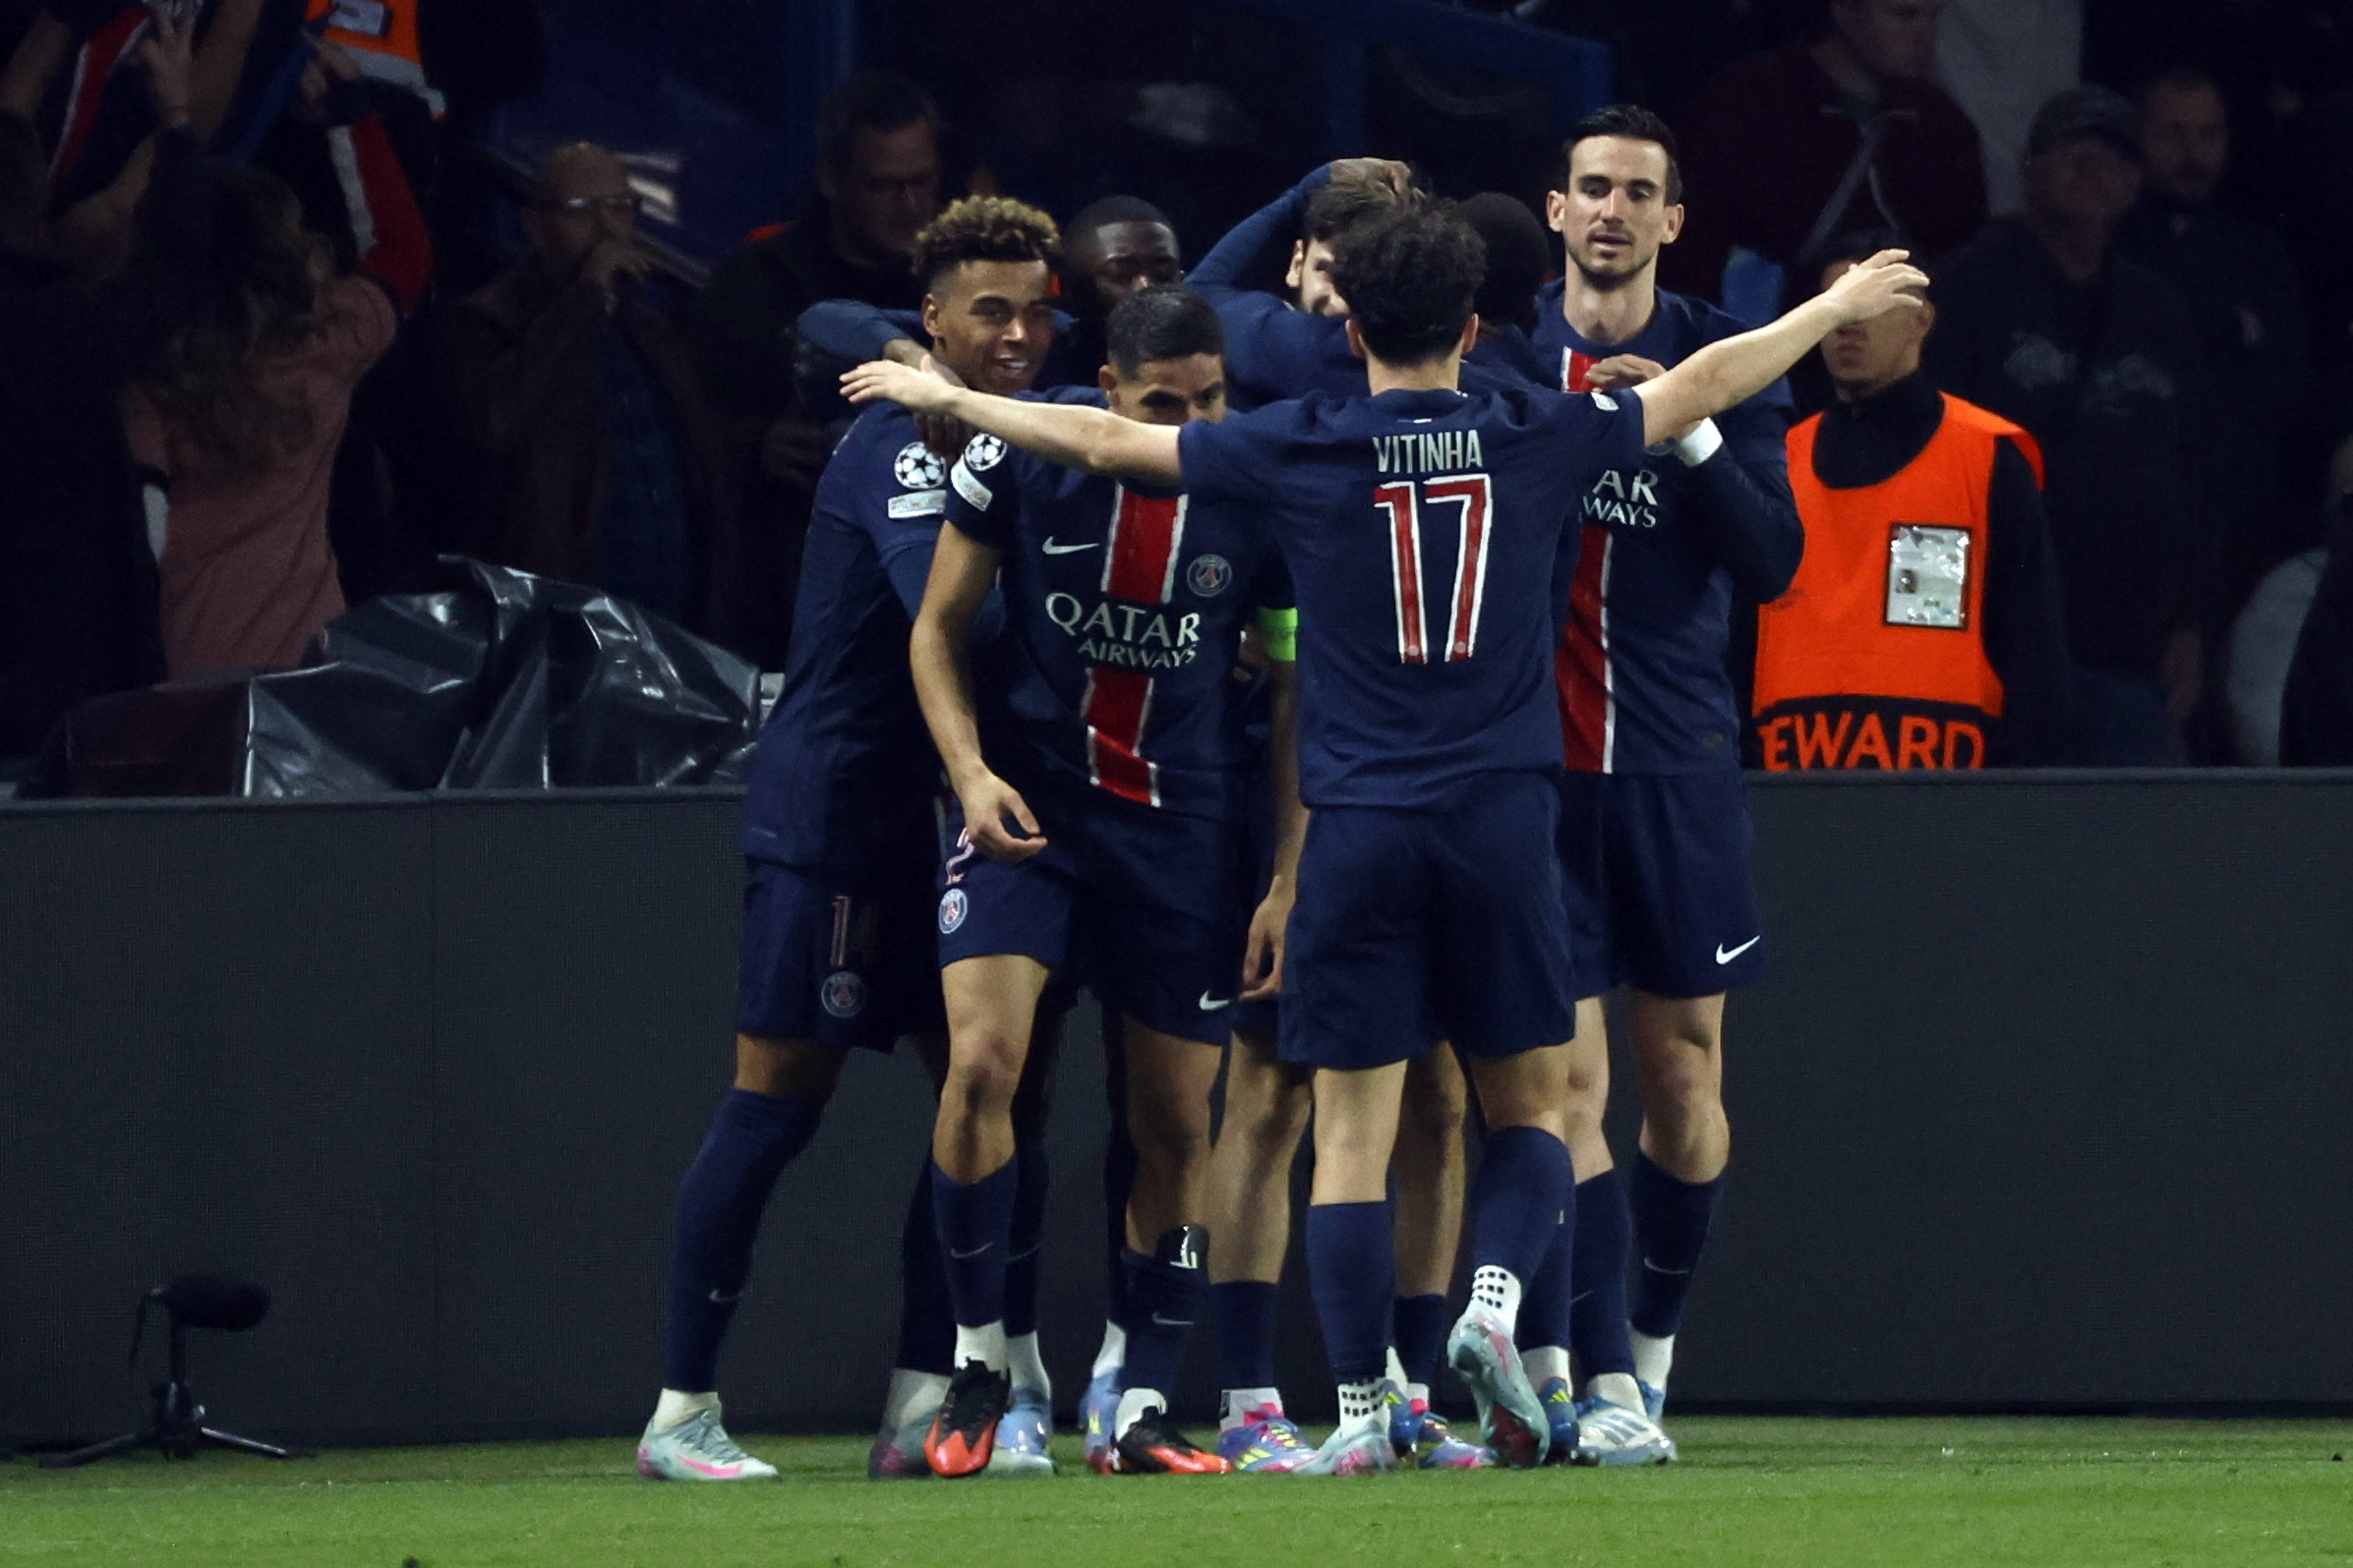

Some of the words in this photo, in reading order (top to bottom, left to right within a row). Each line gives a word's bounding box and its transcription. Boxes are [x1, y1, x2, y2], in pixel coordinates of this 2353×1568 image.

[1372, 429, 1484, 474] VITINHA
[1374, 473, 1494, 665] 17
[1045, 592, 1201, 647] QATAR
[1078, 638, 1197, 668] AIRWAYS
